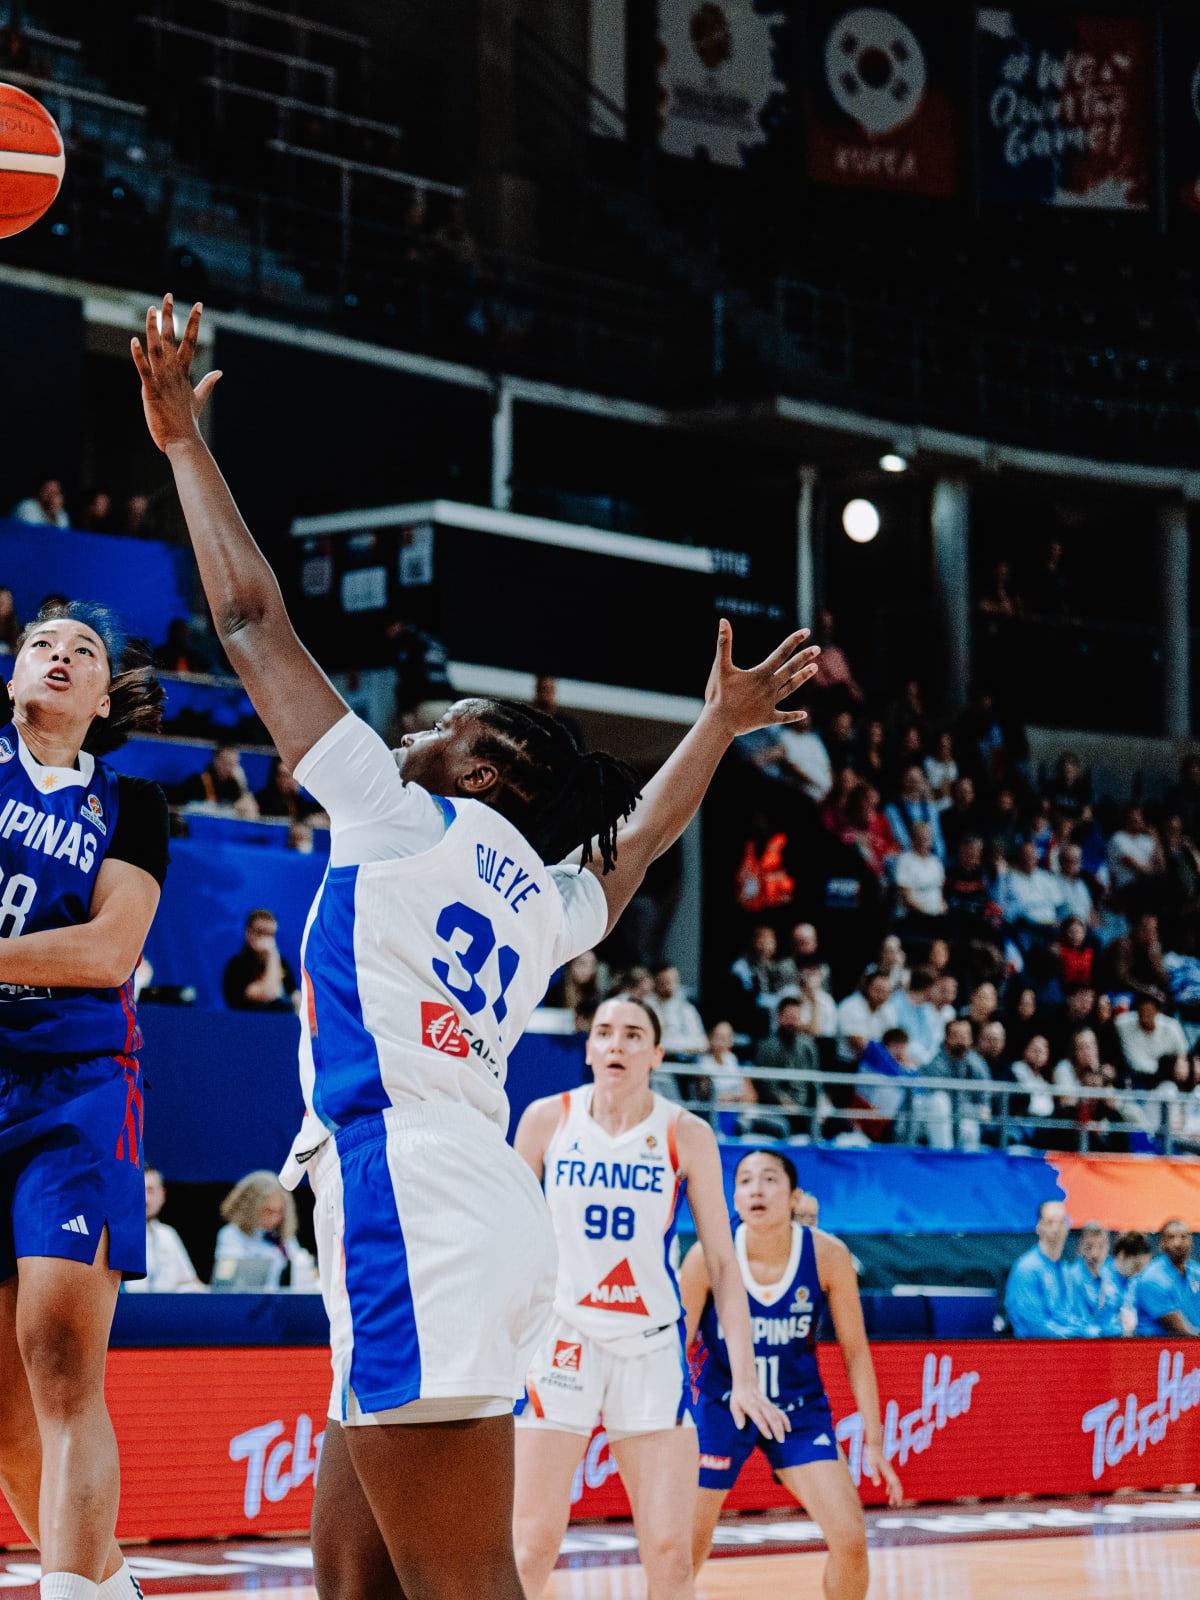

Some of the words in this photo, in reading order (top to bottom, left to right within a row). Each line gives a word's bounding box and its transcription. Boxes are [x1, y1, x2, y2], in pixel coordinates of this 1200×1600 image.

[476, 843, 541, 914] GUEYE
[432, 901, 520, 1042] 31
[555, 1159, 666, 1194] FRANCE
[584, 1203, 636, 1242] 98
[589, 1284, 640, 1304] MAIF
[755, 1355, 780, 1399] 11
